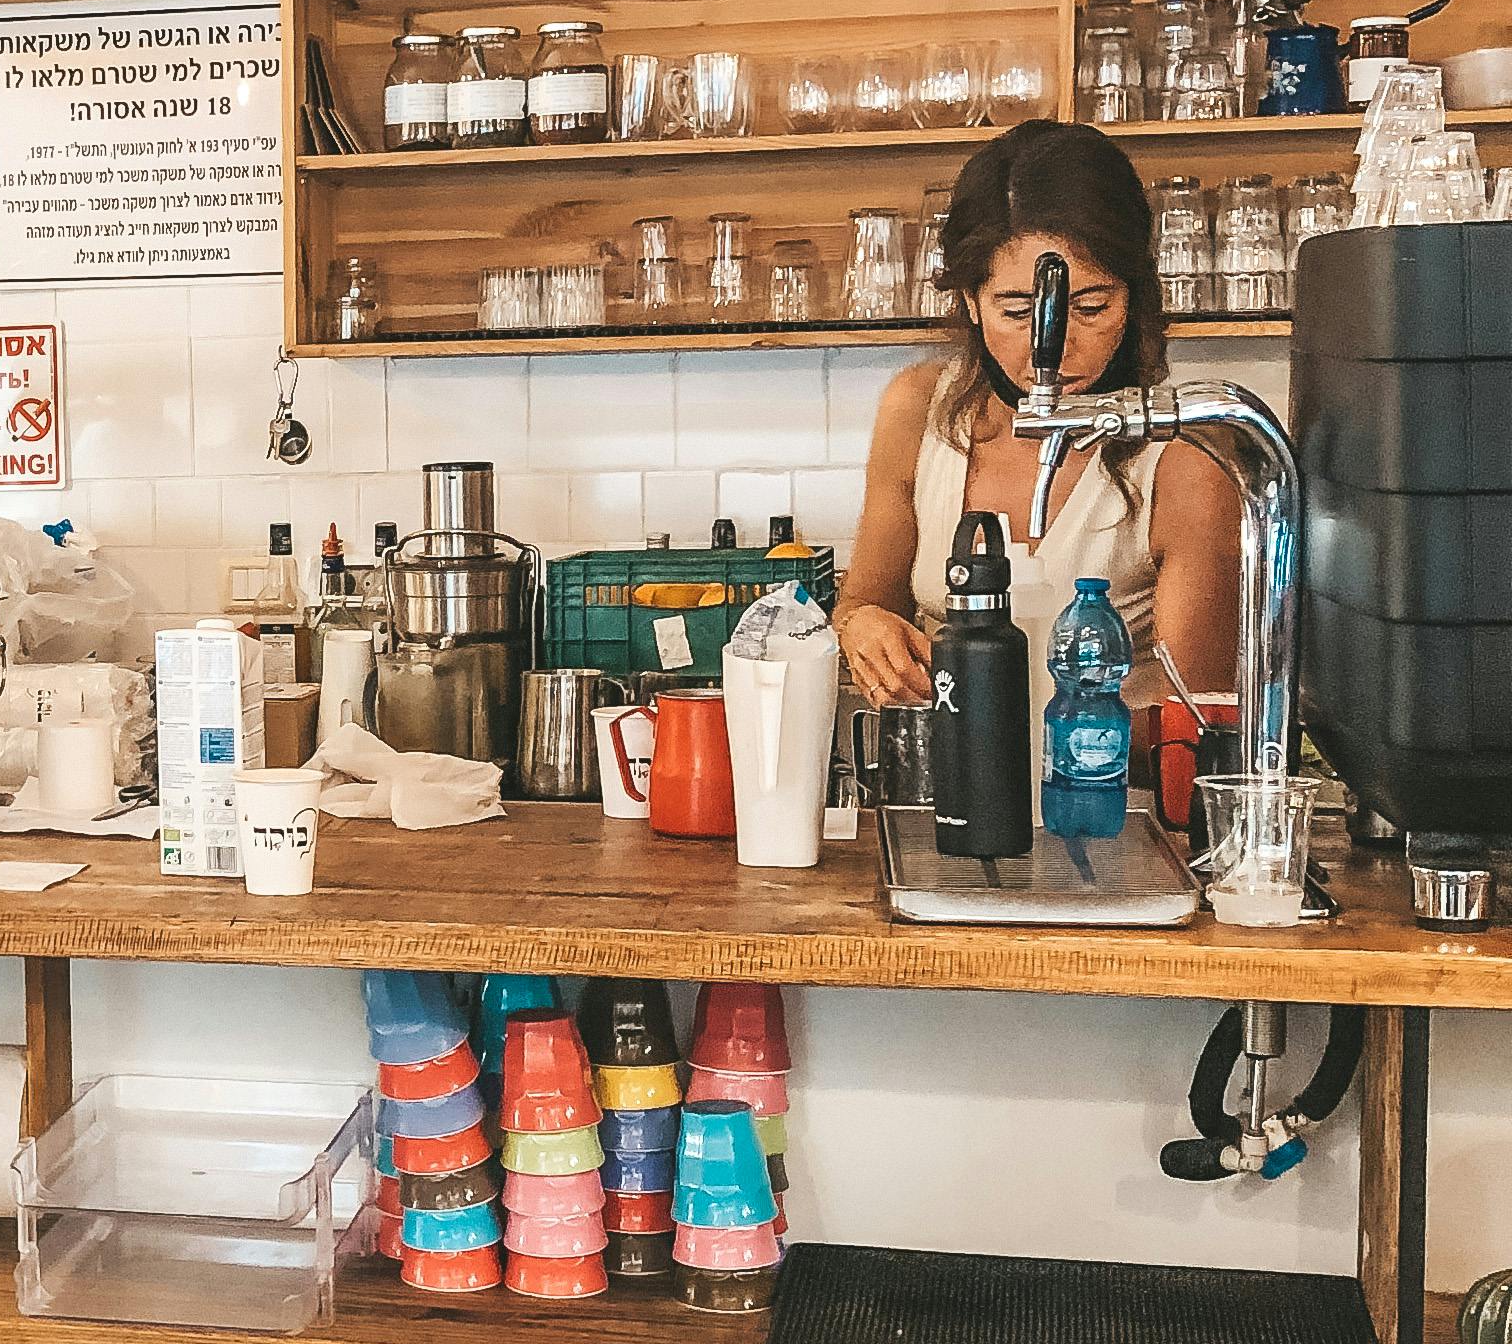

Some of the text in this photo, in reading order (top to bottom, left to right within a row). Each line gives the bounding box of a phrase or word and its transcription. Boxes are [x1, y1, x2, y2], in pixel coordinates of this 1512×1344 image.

[97, 26, 131, 50] של
[138, 27, 201, 49] הגשה
[208, 25, 231, 45] או
[5, 57, 280, 90] שכרים למי שטרם מלאו לו
[70, 96, 232, 122] 18 שנה אסורה!
[156, 136, 184, 159] לחוק
[200, 139, 219, 153] 193
[221, 138, 250, 156] סעיף
[17, 169, 28, 187] לו
[30, 169, 57, 186] מלאו
[59, 171, 93, 185] שטרם
[95, 167, 114, 184] למי
[116, 169, 149, 183] משכר
[151, 168, 187, 186] משקה
[188, 163, 206, 181] של
[208, 165, 250, 183] אספקה
[252, 164, 265, 178] או
[87, 197, 120, 211] משכר
[122, 196, 157, 214] משקה
[159, 191, 191, 213] לצרוך
[193, 193, 227, 208] כאמור
[230, 192, 254, 207] אדם
[26, 225, 55, 239] מזהה
[57, 224, 92, 239] תעודה
[94, 220, 125, 237] להציג
[152, 221, 200, 239] משקאות
[202, 217, 233, 238] לצרוך
[235, 218, 278, 236] המבקש
[97, 250, 115, 264] את
[117, 246, 145, 264] לוודא
[148, 249, 169, 266] ניתן
[171, 247, 231, 263] באמצעותה
